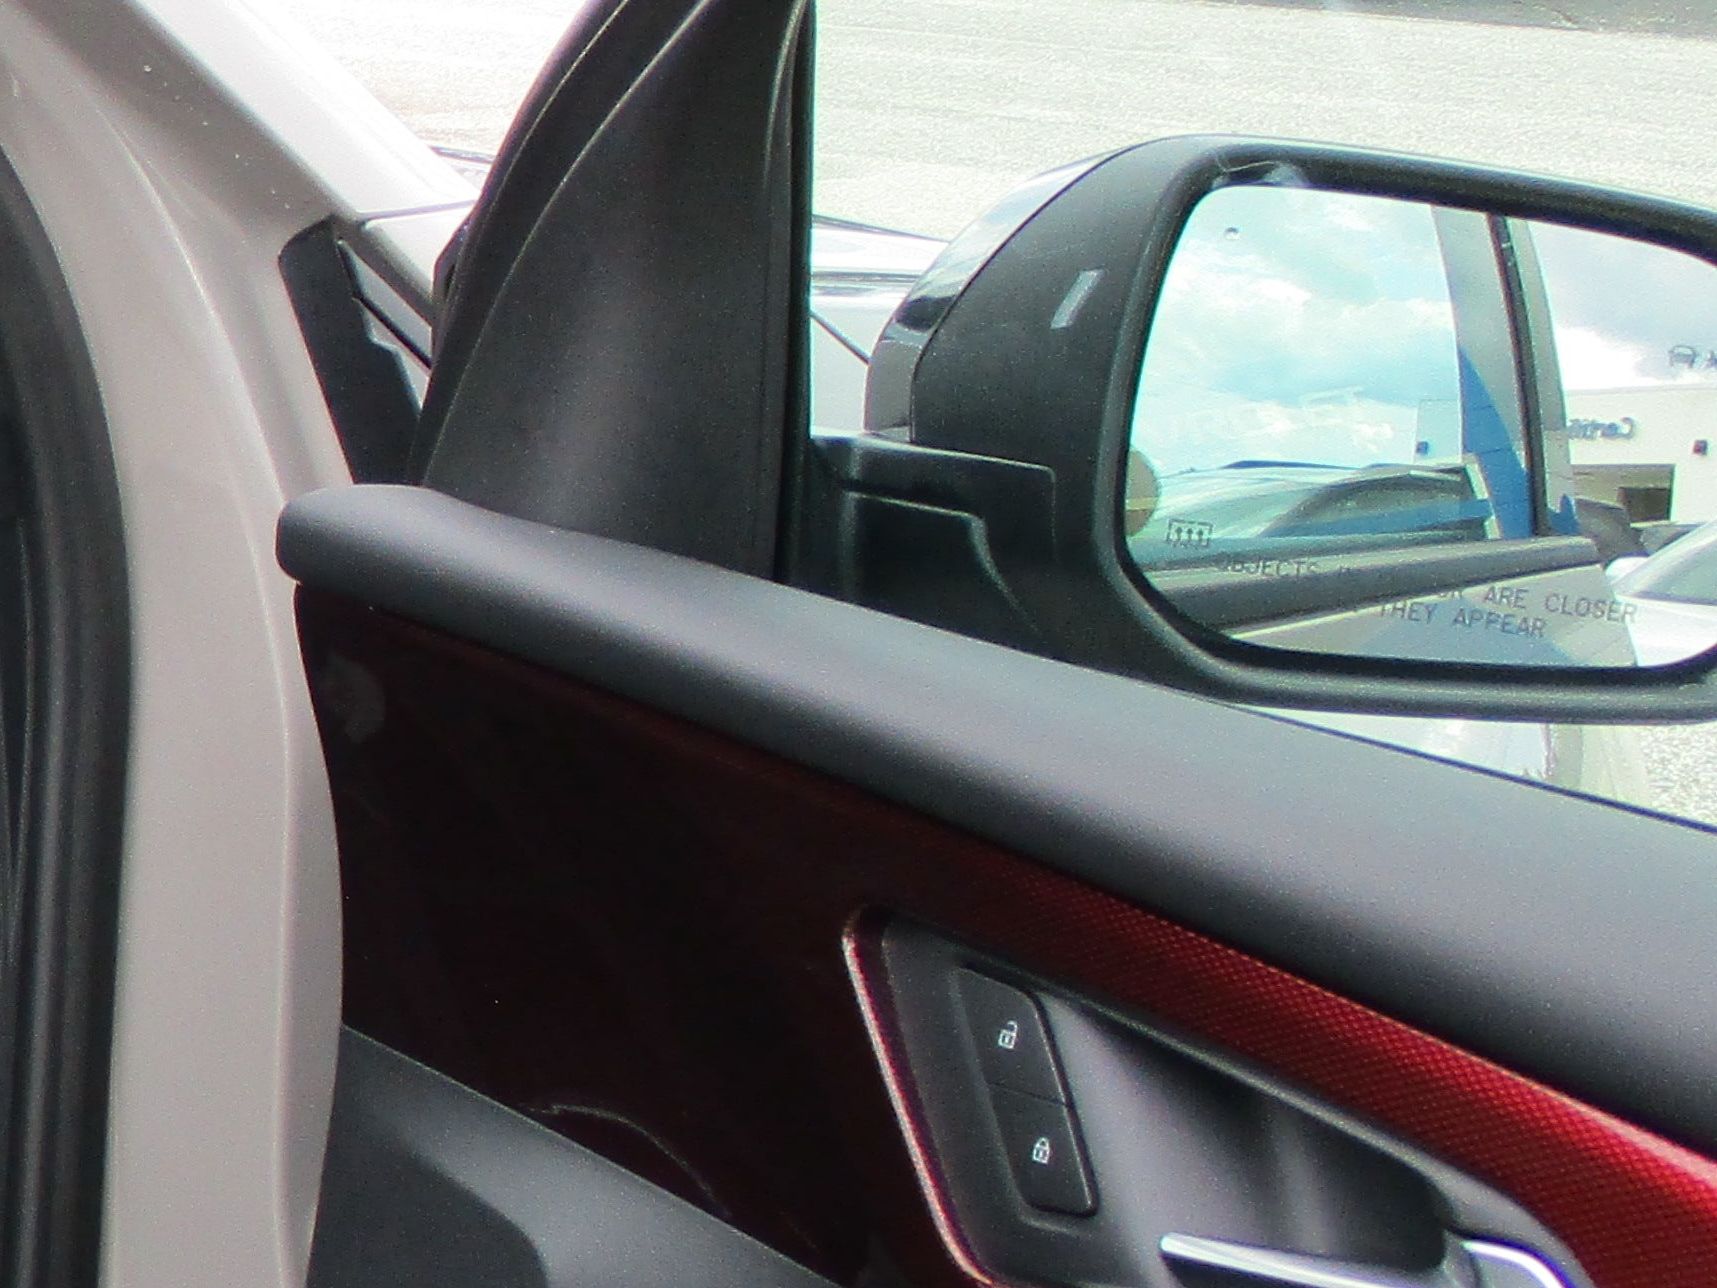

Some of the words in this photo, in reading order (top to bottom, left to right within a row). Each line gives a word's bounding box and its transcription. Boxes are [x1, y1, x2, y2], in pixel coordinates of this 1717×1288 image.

[1378, 600, 1437, 627] THEY
[1452, 609, 1547, 639] APPEAR
[1484, 585, 1528, 610] ARE
[1544, 592, 1637, 624] CLOSER
